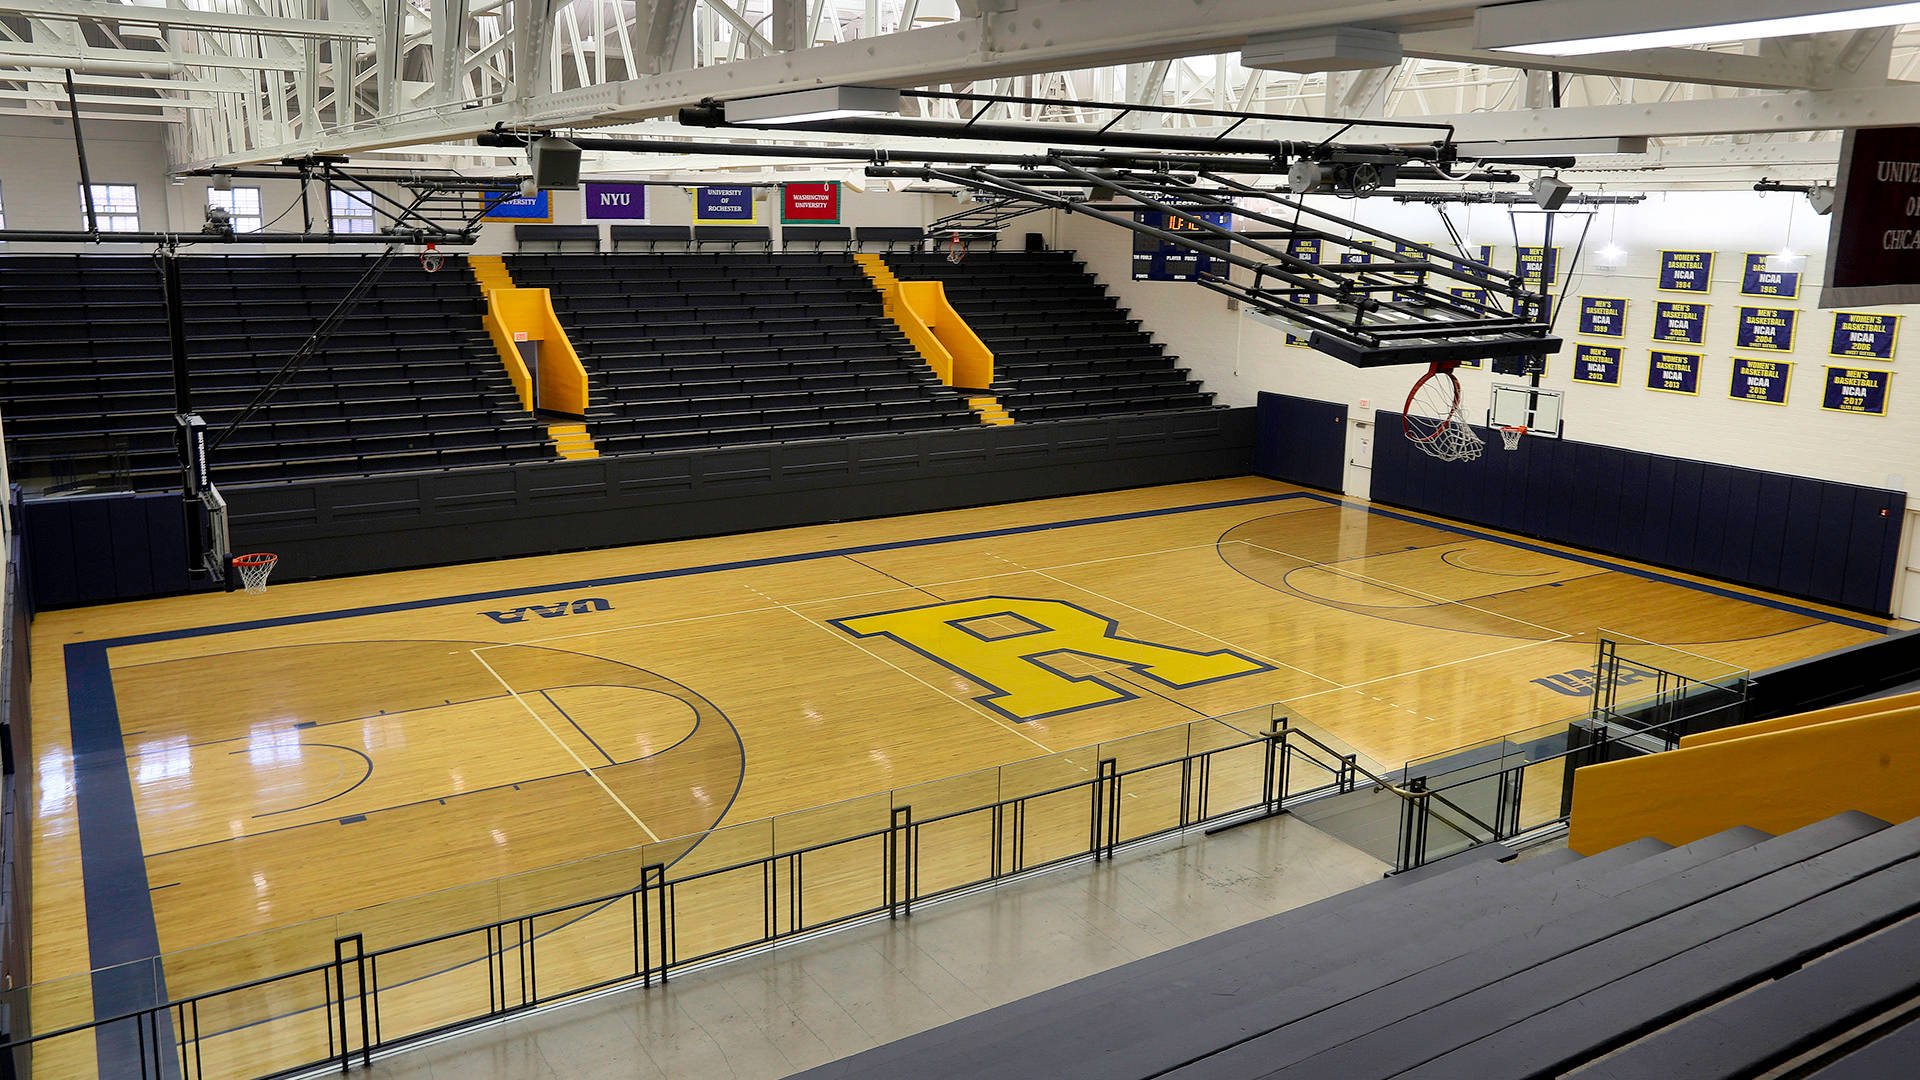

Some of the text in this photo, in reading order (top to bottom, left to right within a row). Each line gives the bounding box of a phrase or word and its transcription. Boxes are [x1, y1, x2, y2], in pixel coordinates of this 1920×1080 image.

[600, 193, 631, 206] NYU
[1673, 254, 1701, 262] WOMEN'S
[1668, 260, 1703, 270] BASKETBALL
[1674, 270, 1695, 280] NCAA
[1759, 273, 1781, 284] NCAA
[1586, 307, 1618, 316] BASKETBALL
[1672, 304, 1690, 312] MEN'S
[1757, 309, 1777, 317] MEN'S
[1592, 315, 1611, 325] NCAA
[1662, 310, 1698, 320] BASKETBALL
[1849, 315, 1882, 325] WOMEN'S
[1668, 319, 1689, 329] NCAA
[1746, 316, 1786, 327] BASKETBALL
[1753, 325, 1776, 336] NCAA
[1841, 323, 1886, 333] BASKETBALL
[1849, 332, 1875, 343] NCAA
[1590, 348, 1607, 356] MEN'S
[1581, 355, 1614, 364] BASKETBALL
[1661, 355, 1688, 364] WOMEN'S
[1587, 363, 1606, 373] NCAA
[1656, 362, 1692, 372] BASKETBALL
[1747, 361, 1776, 371] WOMEN'S
[1662, 371, 1682, 381] NCAA
[1740, 367, 1780, 379] BASKETBALL
[1845, 371, 1869, 380] MEN'S
[1663, 381, 1680, 389] 2013
[1747, 376, 1770, 388] NCAA
[1834, 376, 1879, 388] BASKETBALL
[1841, 386, 1867, 397] NCAA
[1843, 397, 1864, 406] 2017
[476, 598, 616, 624] UAA
[825, 595, 1279, 724] R
